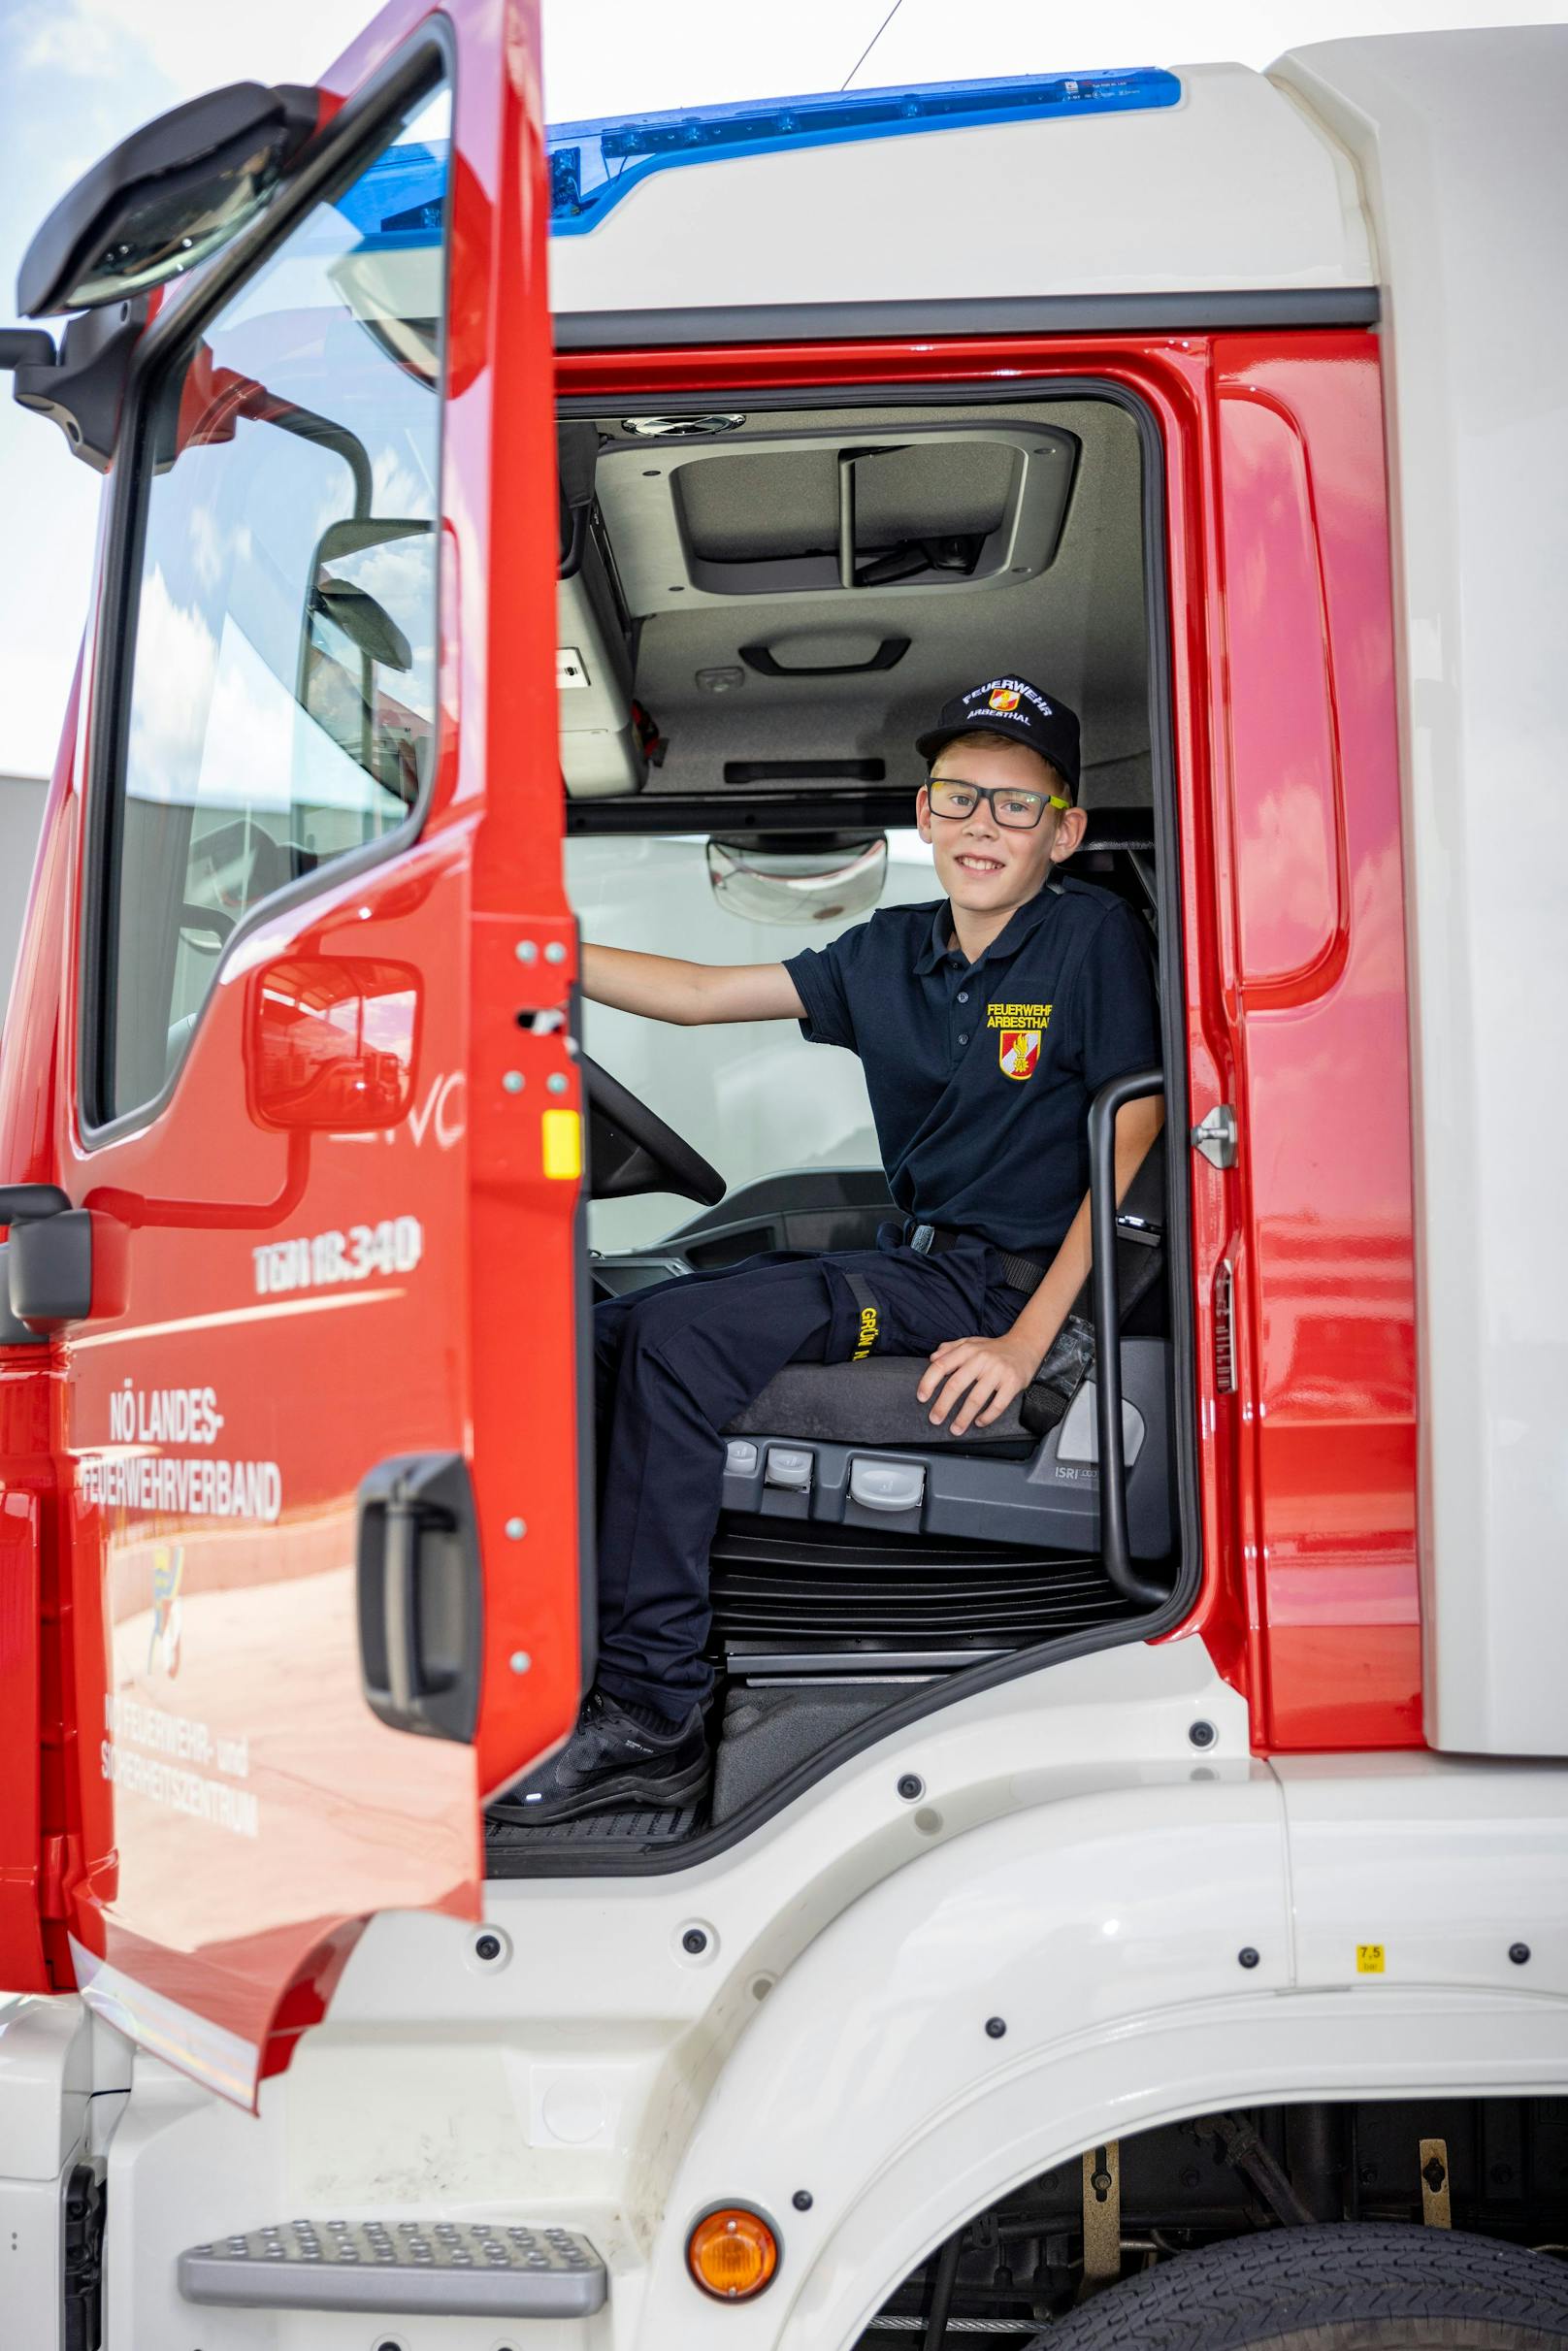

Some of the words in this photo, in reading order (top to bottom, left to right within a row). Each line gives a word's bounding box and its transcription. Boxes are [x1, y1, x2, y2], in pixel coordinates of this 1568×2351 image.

[962, 679, 1053, 717] FEUERWEHR
[966, 708, 1031, 727] ARBESTHAL
[987, 1016, 1050, 1029] ARBESTHA
[311, 1215, 423, 1287] 18.340
[858, 1307, 879, 1347] GRÜN
[110, 1377, 137, 1443] NÖ
[138, 1386, 225, 1445] LANDES-
[81, 1455, 282, 1521] FEUERWEHRVERBAND
[1055, 1466, 1079, 1480] ISRI
